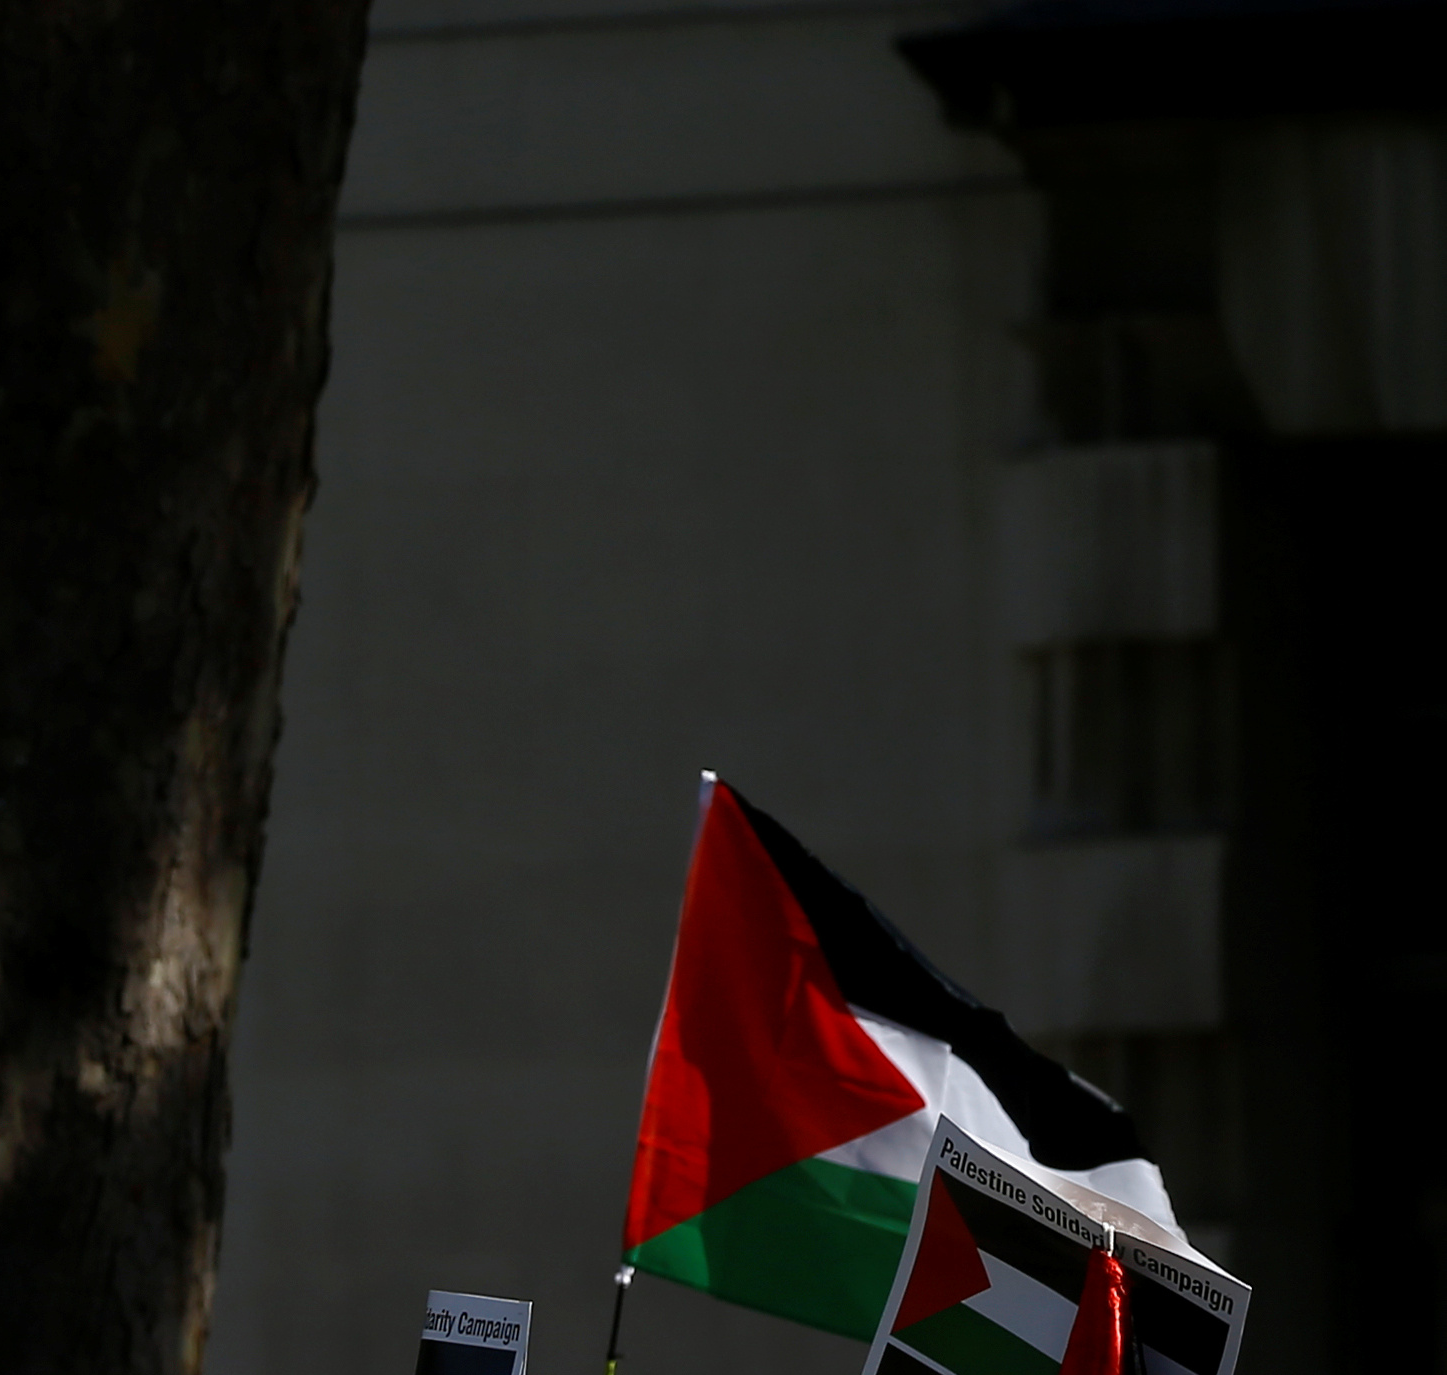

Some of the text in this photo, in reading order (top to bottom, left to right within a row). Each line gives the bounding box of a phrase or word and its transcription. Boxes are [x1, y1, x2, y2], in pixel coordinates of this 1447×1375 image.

[941, 1137, 1235, 1315] Palestine Solidariy Campaign
[458, 1312, 520, 1345] Campaign
